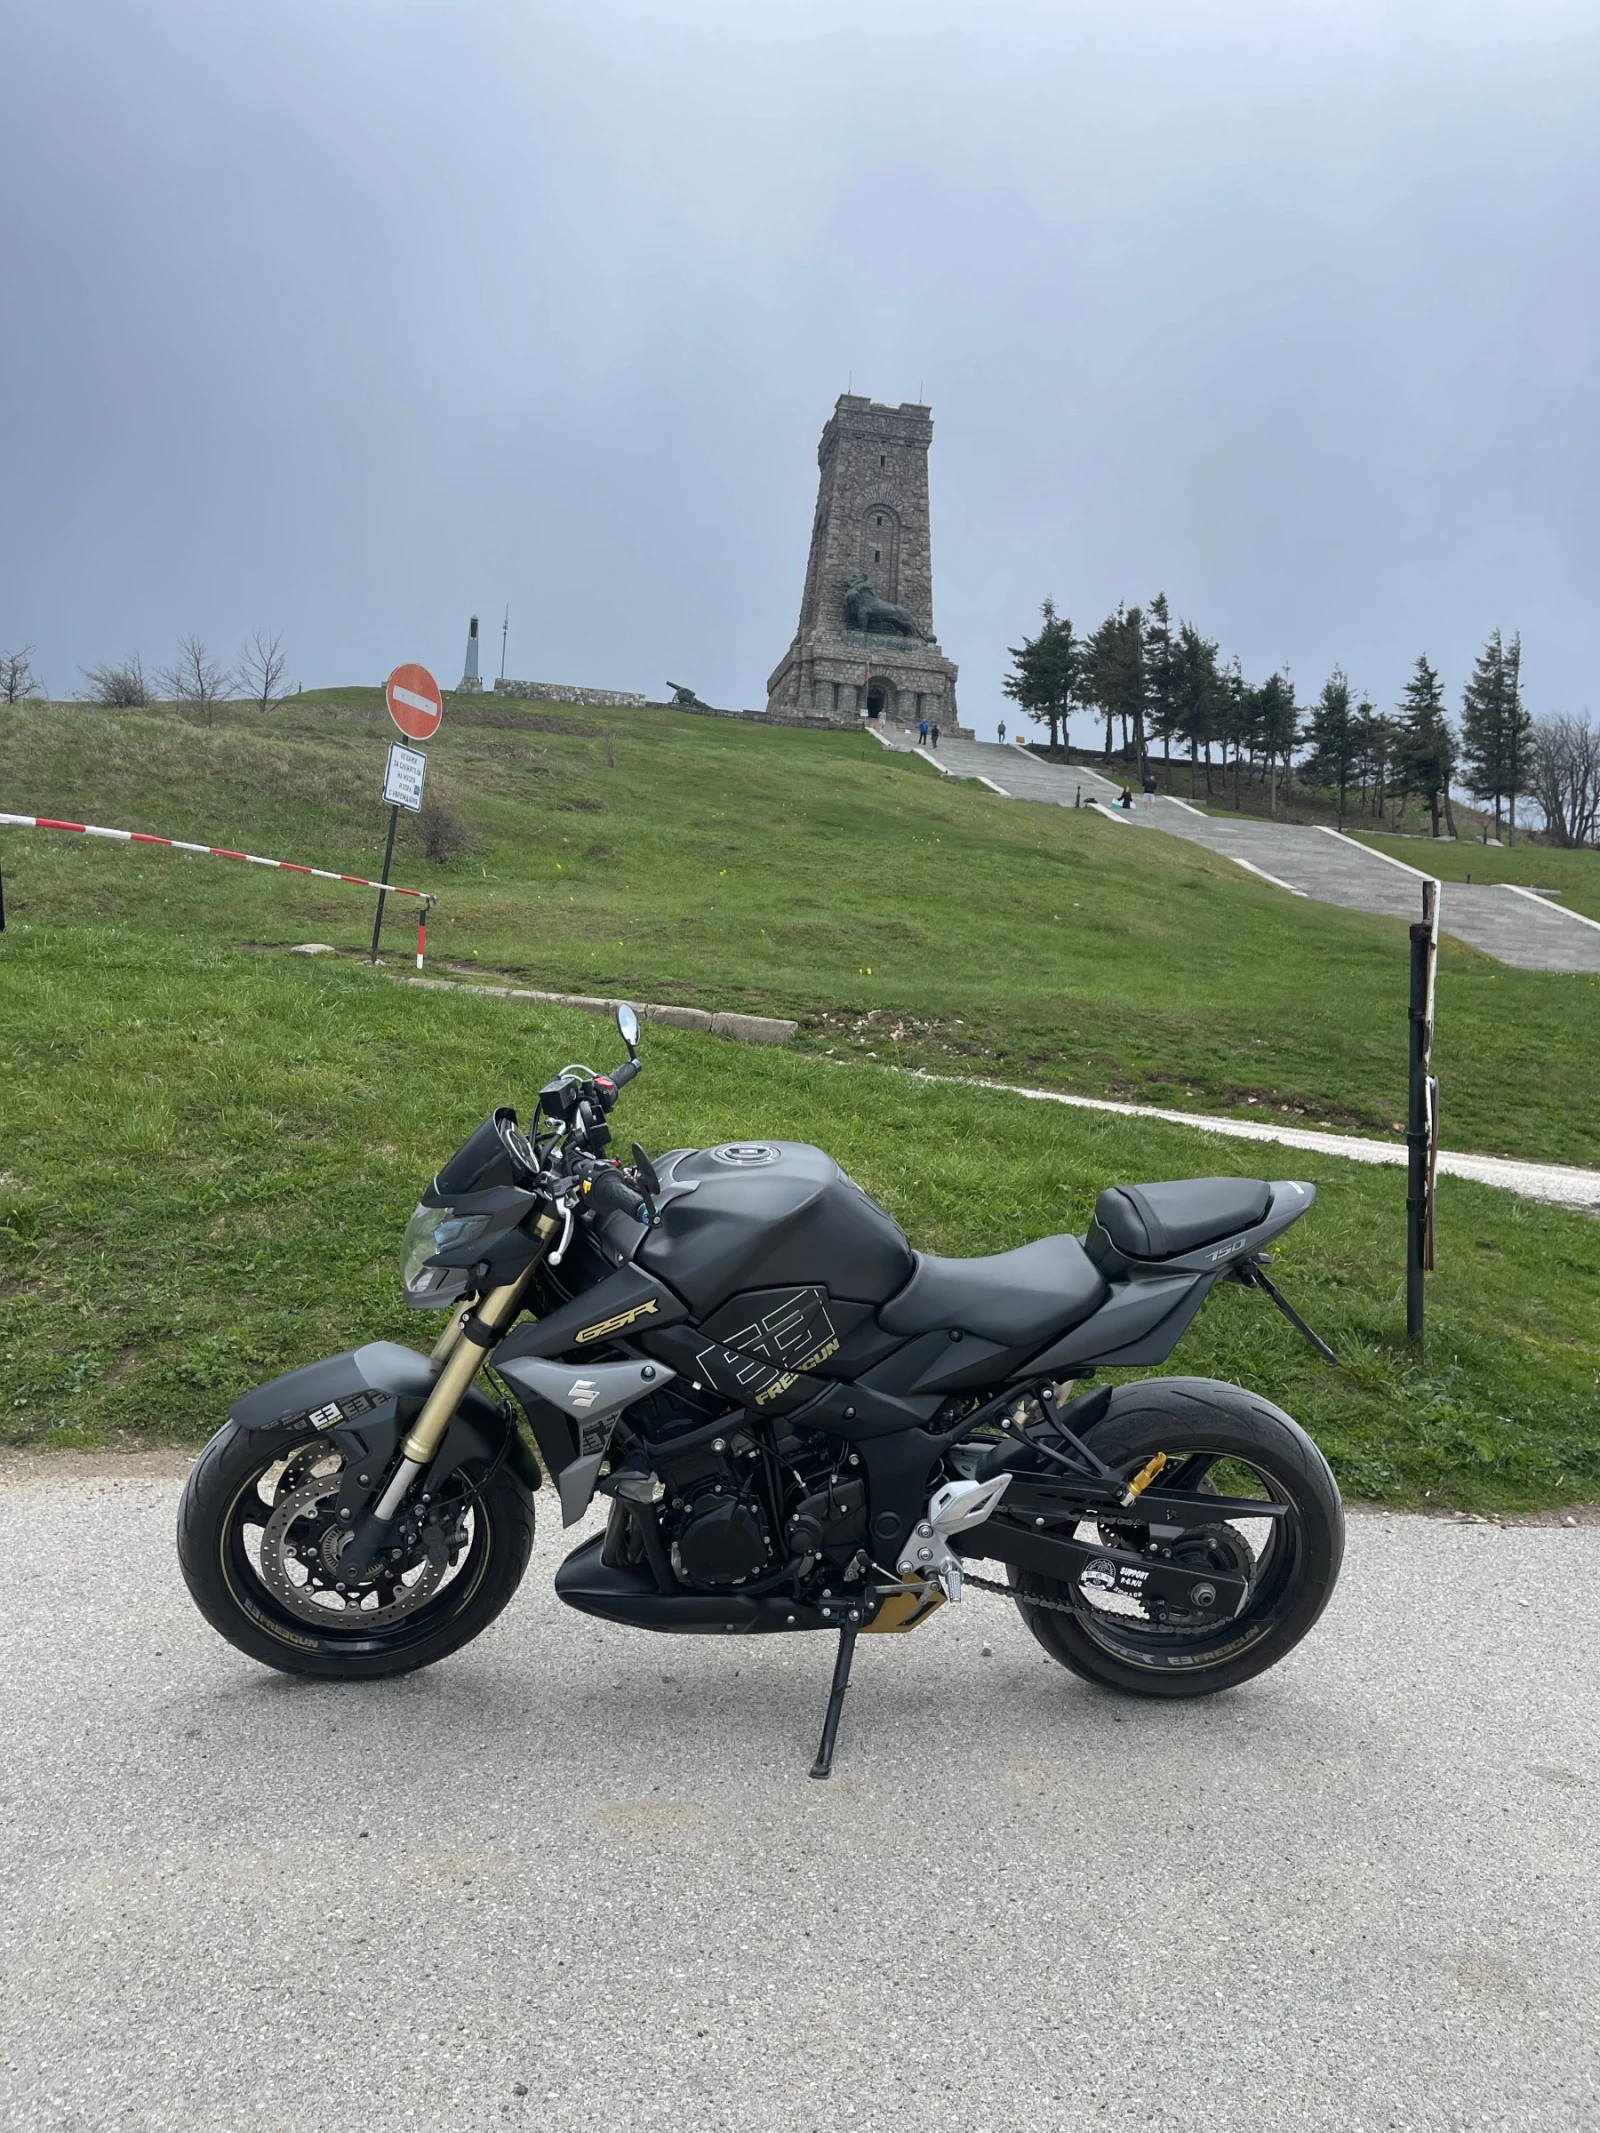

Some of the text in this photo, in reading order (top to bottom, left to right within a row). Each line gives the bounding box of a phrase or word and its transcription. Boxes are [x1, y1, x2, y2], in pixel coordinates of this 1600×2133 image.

[1205, 1238, 1247, 1261] 750
[575, 1299, 659, 1343] GSR
[1119, 1567, 1150, 1580] SUPPORT
